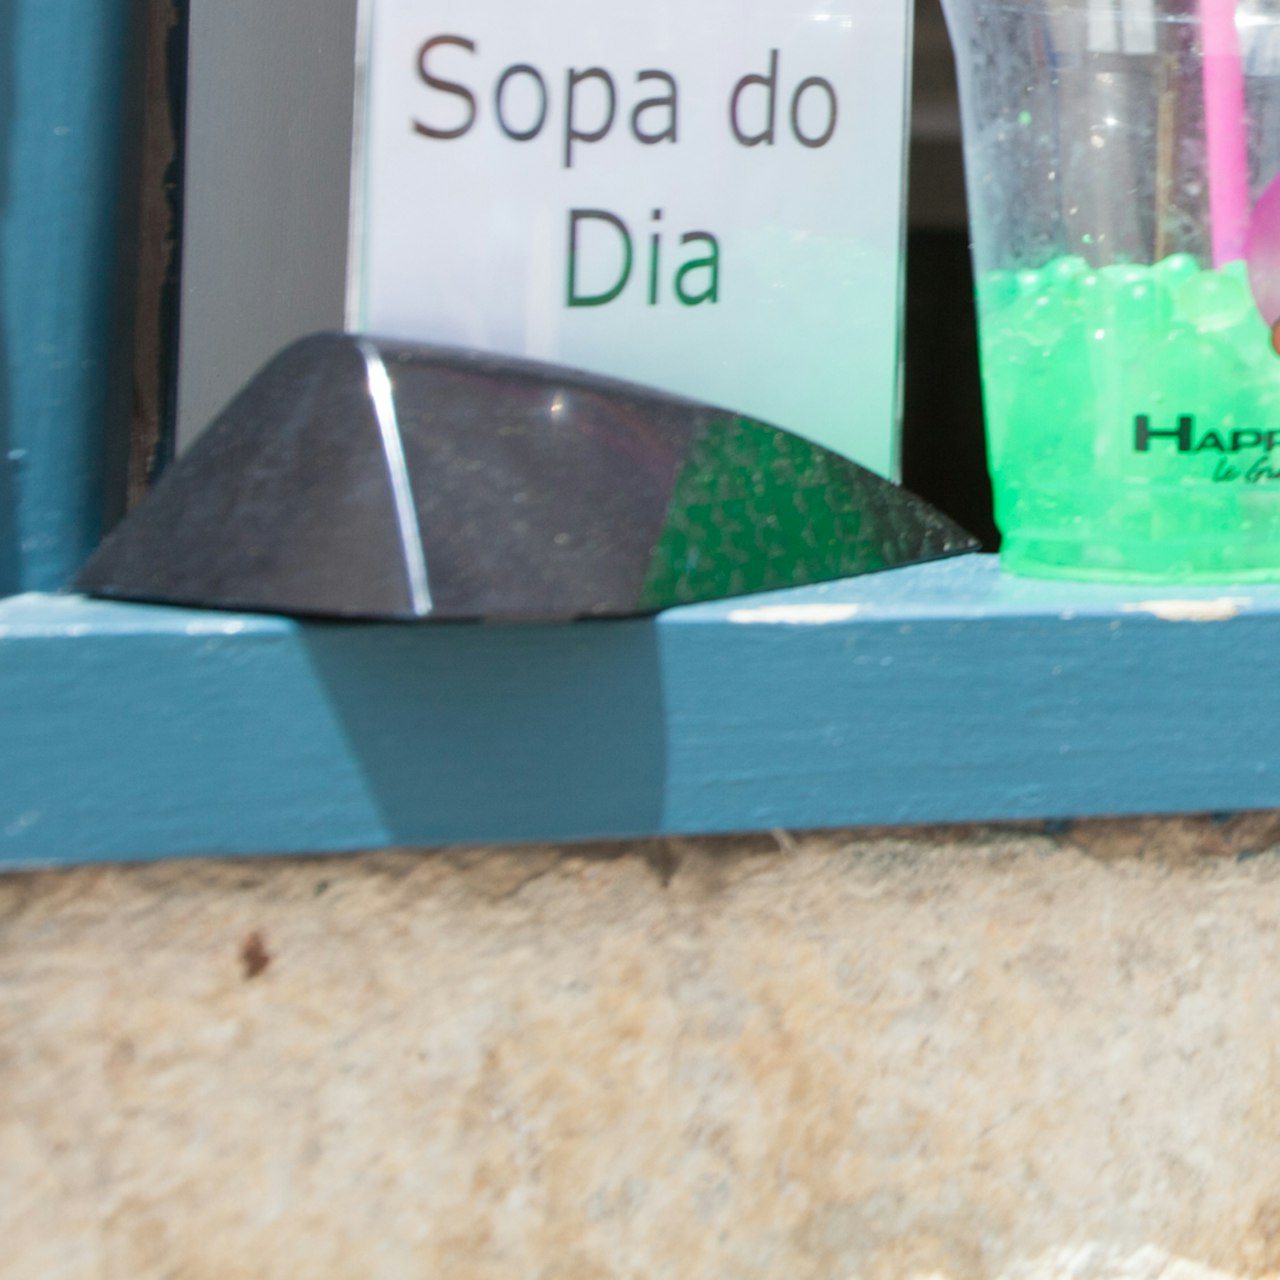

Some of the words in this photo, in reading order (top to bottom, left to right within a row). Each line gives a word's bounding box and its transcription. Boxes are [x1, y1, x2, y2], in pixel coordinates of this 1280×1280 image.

[410, 34, 679, 169] Sopa
[728, 48, 839, 149] do
[564, 207, 722, 309] Dia
